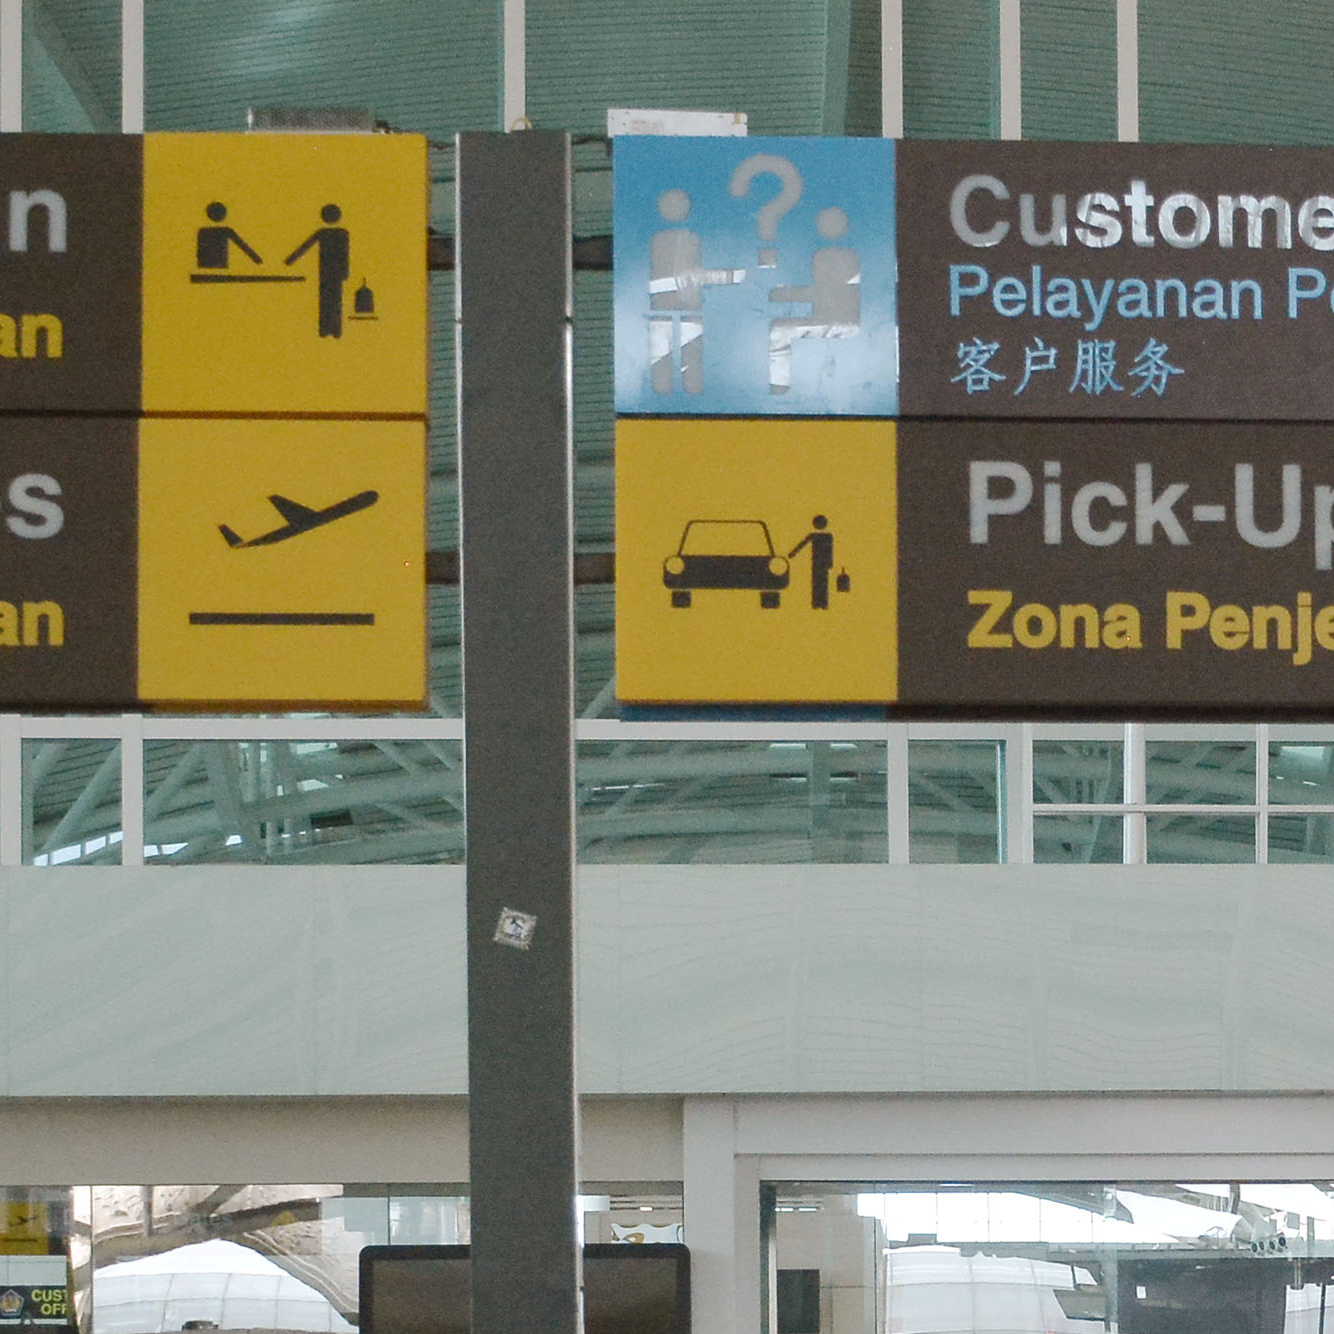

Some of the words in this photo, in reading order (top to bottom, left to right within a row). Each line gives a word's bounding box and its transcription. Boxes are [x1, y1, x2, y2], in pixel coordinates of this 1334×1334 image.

[949, 264, 1264, 332] Pelayanan
[949, 337, 1184, 397] 客户服务
[967, 588, 1143, 651] Zona
[31, 1289, 67, 1302] CUST
[41, 1303, 67, 1315] OFF
